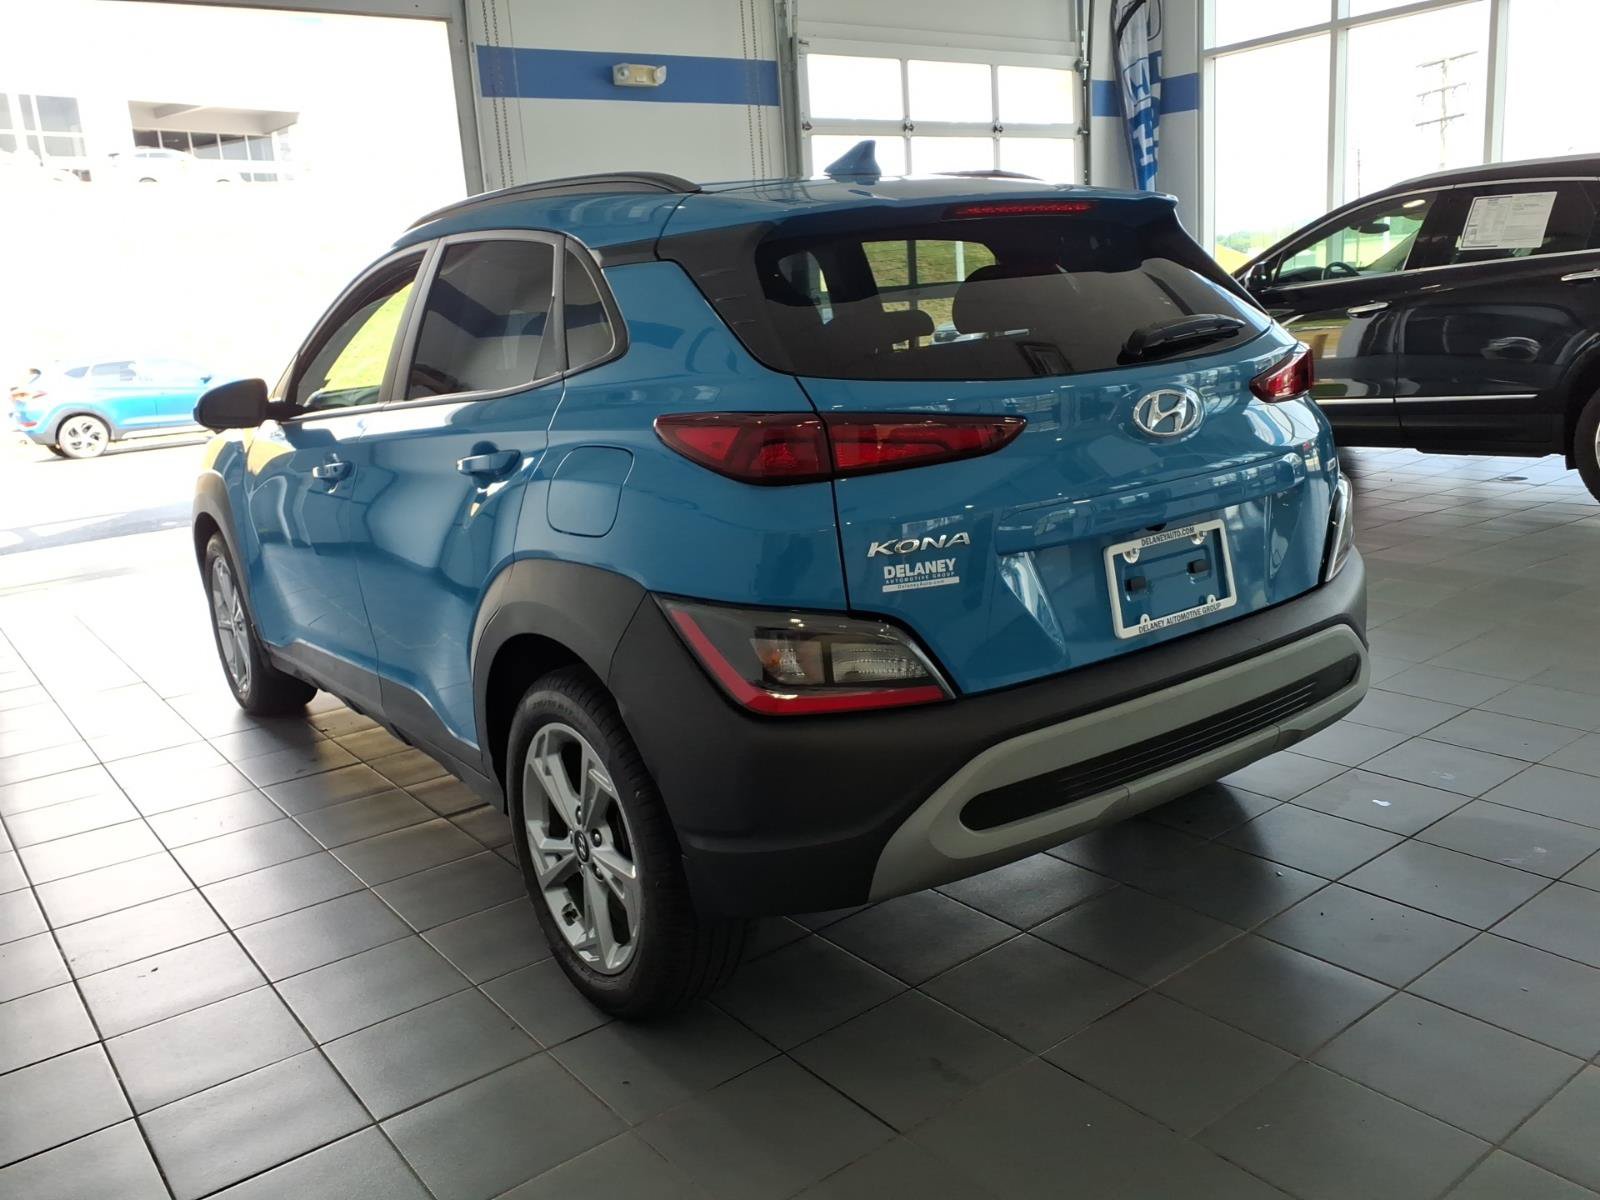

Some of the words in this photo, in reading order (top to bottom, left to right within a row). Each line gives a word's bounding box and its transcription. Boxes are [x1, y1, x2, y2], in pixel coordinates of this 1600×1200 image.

[867, 532, 970, 557] KONA
[1141, 527, 1195, 546] DELANEYAUTO.COM
[883, 558, 956, 579] DELANEY
[885, 574, 929, 584] AUTOMOTIVE
[932, 571, 955, 579] GROUP
[1138, 619, 1166, 633] DELANEY
[1166, 608, 1202, 625] AUTOMOTIVE
[1202, 602, 1222, 614] GROUP
